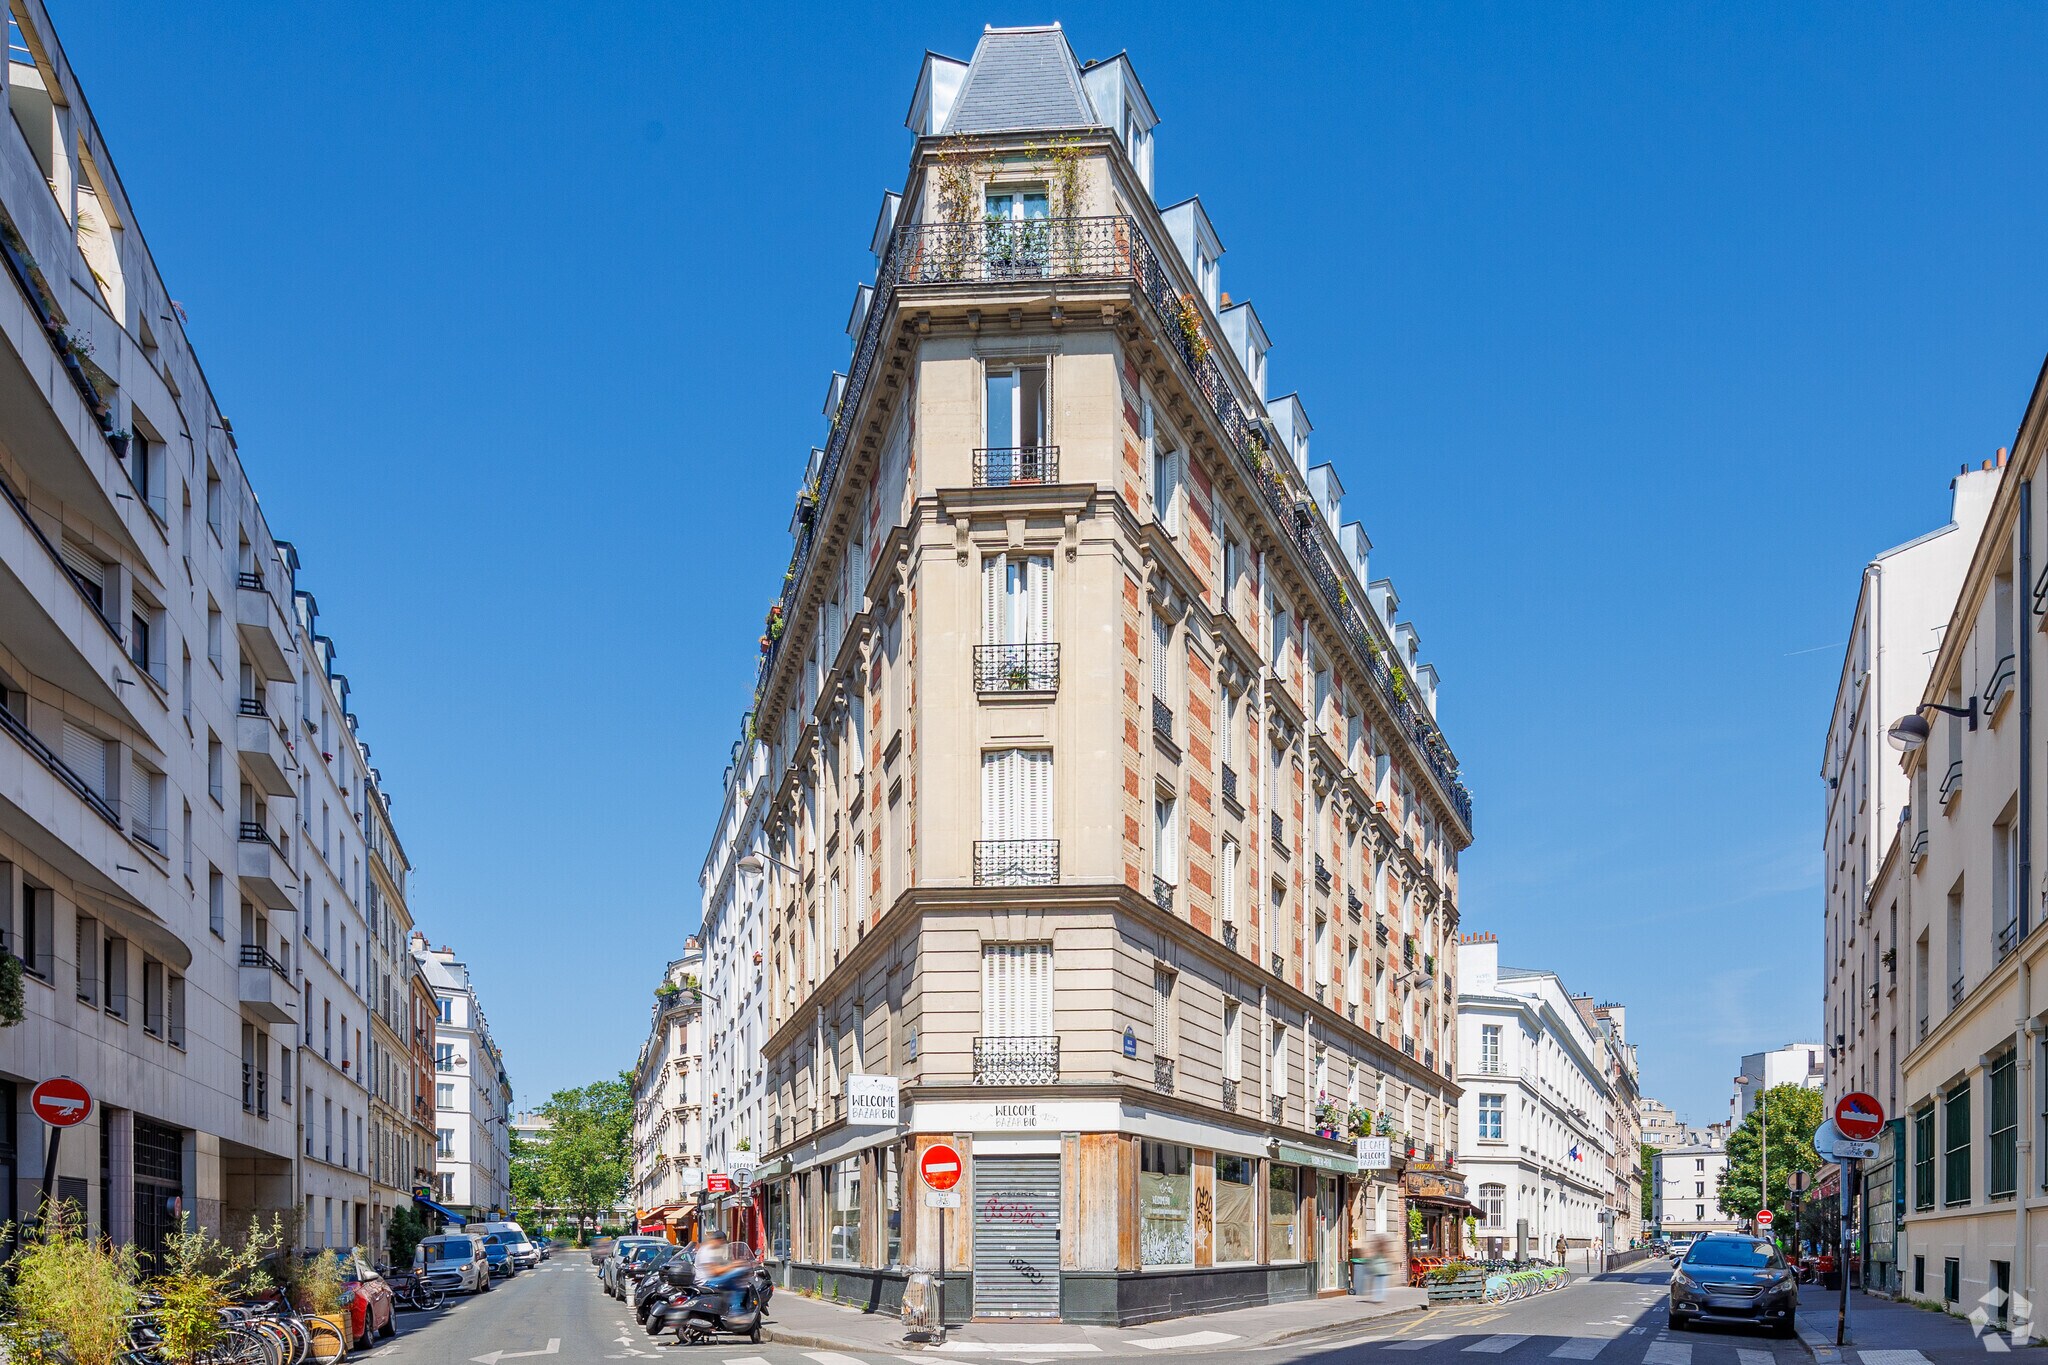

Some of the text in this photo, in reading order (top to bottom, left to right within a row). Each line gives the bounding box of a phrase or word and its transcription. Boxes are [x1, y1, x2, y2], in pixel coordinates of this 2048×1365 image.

[852, 1094, 896, 1108] WELCOME
[852, 1108, 896, 1119] BAZAR BIO
[995, 1105, 1036, 1116] WELCOME
[995, 1117, 1022, 1127] BAZAR
[1023, 1117, 1037, 1127] BIO
[1360, 1138, 1386, 1150] LE CAFÉ
[1360, 1152, 1386, 1160] WELCOME
